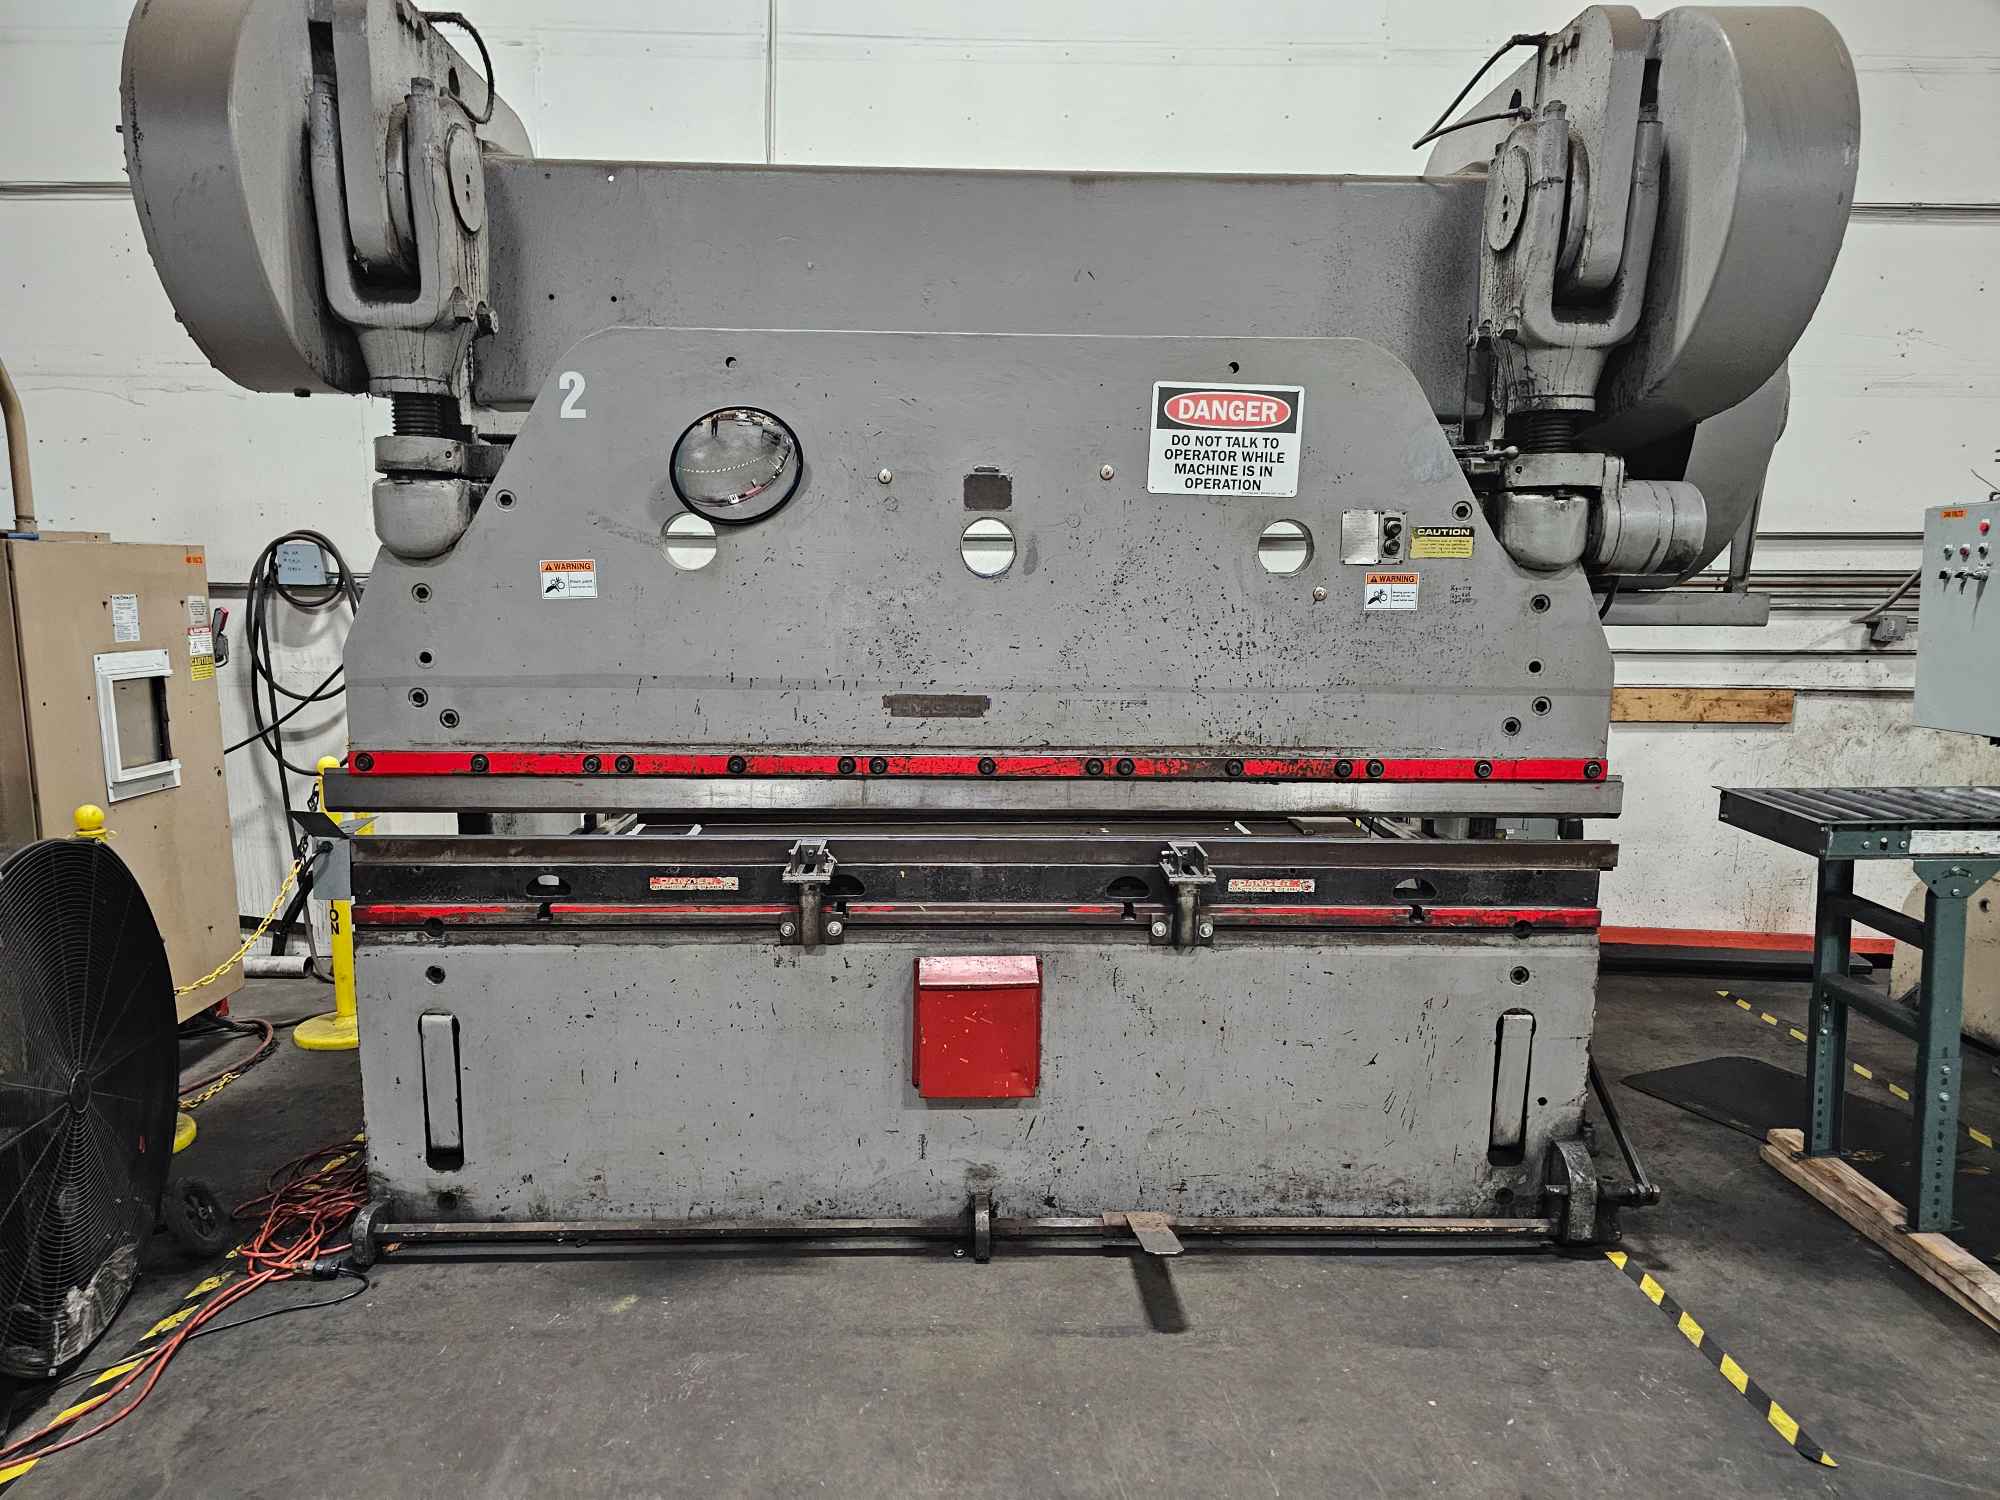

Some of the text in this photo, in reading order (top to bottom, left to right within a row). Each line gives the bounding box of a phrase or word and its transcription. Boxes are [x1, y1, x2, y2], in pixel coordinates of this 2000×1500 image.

[560, 371, 586, 418] 2
[1178, 398, 1278, 423] DANGER
[1171, 434, 1279, 449] DO NOT TALK TO
[1164, 449, 1285, 463] OPERATOR WHILE
[1174, 464, 1273, 477] MACHINE IS IN
[1184, 477, 1262, 491] OPERATION
[1417, 528, 1470, 536] CAUTION
[553, 562, 591, 570] WARNING
[1379, 575, 1415, 583] WARNING
